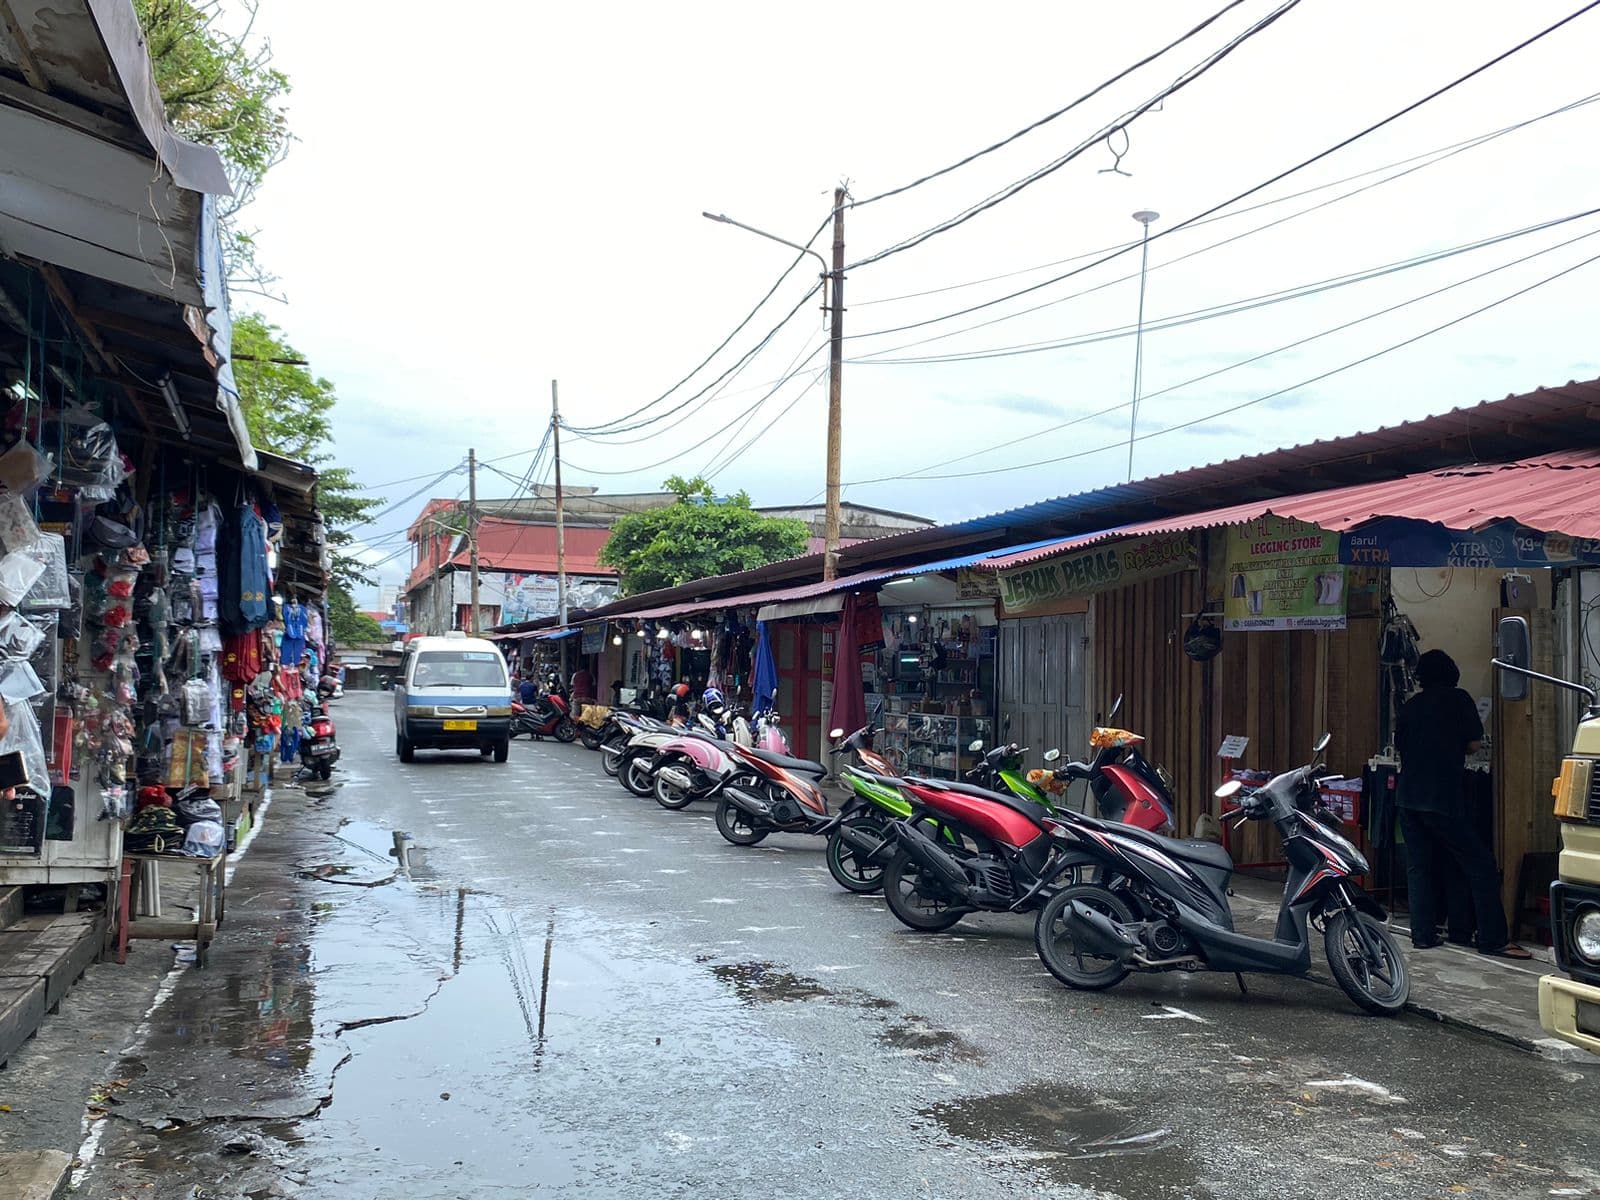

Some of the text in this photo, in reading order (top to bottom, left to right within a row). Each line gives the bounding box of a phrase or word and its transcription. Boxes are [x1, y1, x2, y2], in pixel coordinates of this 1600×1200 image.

[1250, 535, 1322, 555] LEGGING STORE
[1350, 535, 1378, 546] Baru!
[1351, 548, 1390, 562] XTRA
[1448, 541, 1491, 558] XTRA
[1004, 566, 1062, 604] JERUK
[1061, 550, 1121, 588] PERAS
